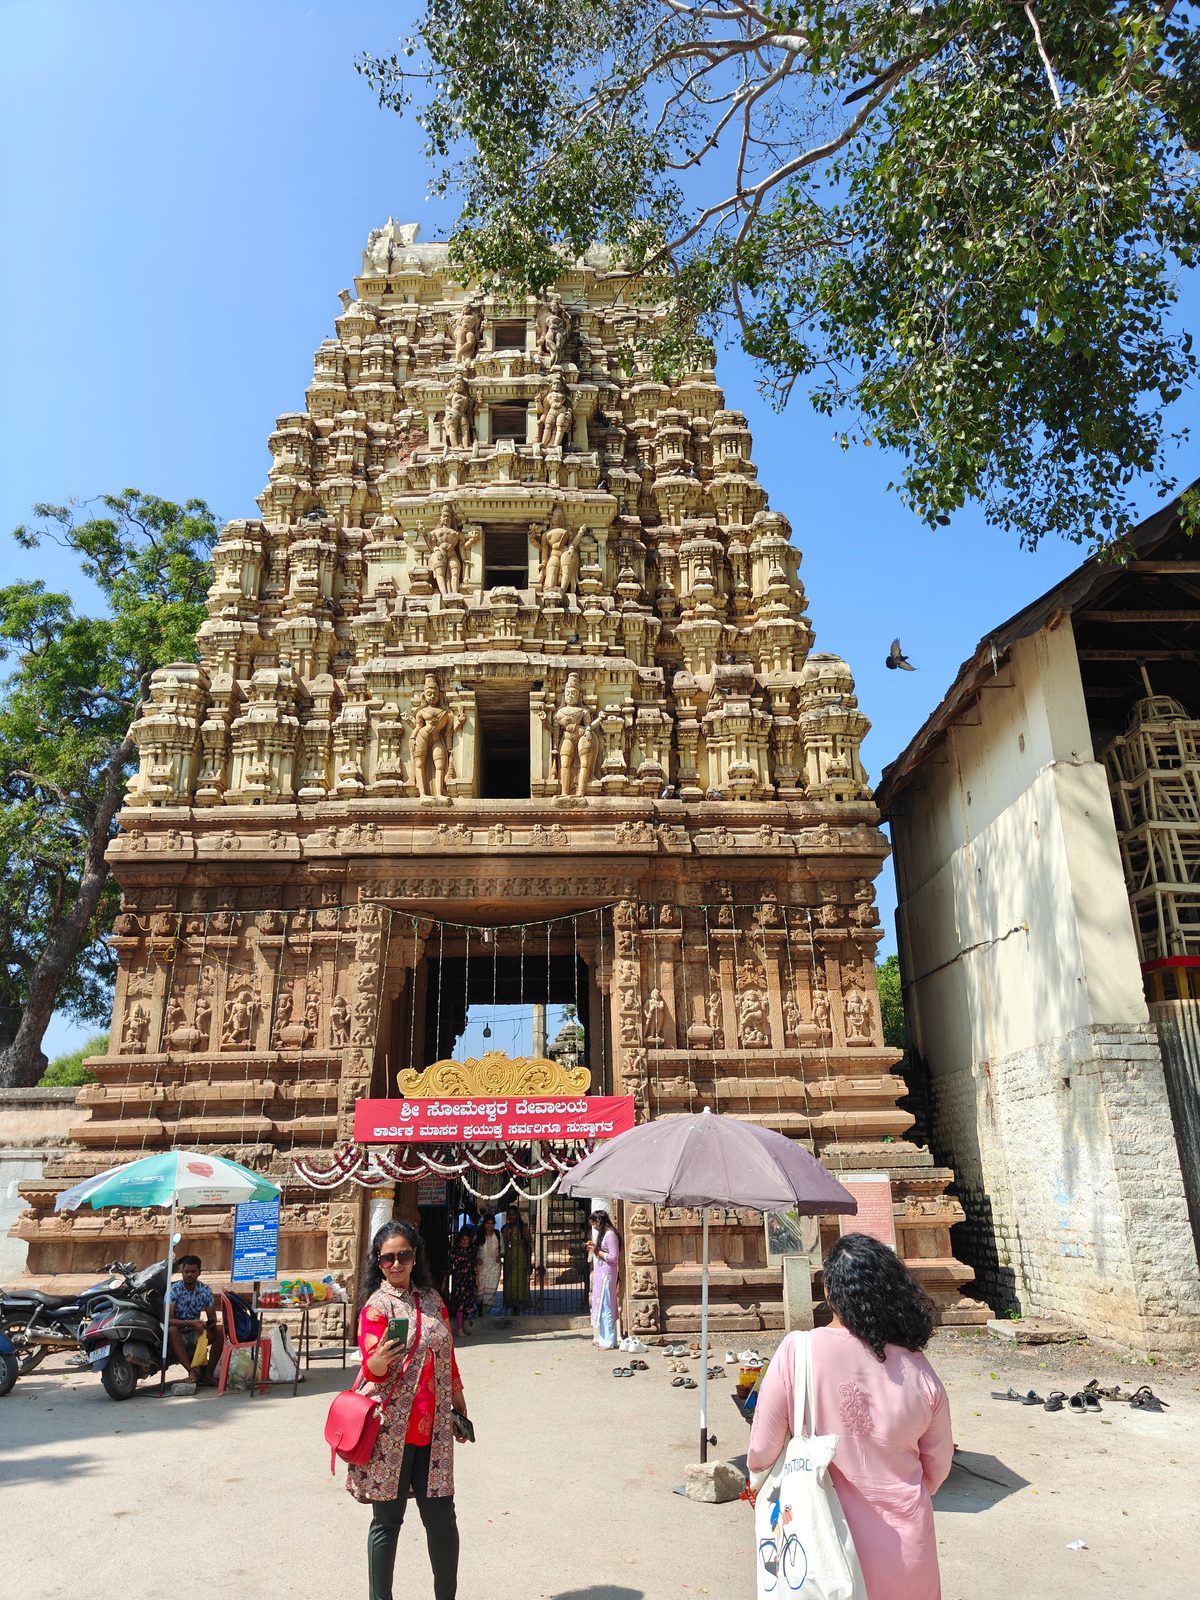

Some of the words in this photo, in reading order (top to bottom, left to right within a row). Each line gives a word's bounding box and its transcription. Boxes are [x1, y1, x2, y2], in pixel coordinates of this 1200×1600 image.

[400, 1102, 420, 1121] ಶ್ರೀ
[427, 1101, 508, 1122] ಸೋಮೇಶ್ವರ
[515, 1099, 588, 1115] ದೇವಾಲಯ
[373, 1125, 414, 1137] ಕಾರ್ತಿಕ
[420, 1125, 458, 1137] ಮಾಸದ
[463, 1124, 503, 1139] ಪ್ರಯುಕ್ತ
[508, 1122, 562, 1135] ಸರ್ವರಿಗೂ
[567, 1121, 614, 1138] ಸುಸ್ವಾಗತ
